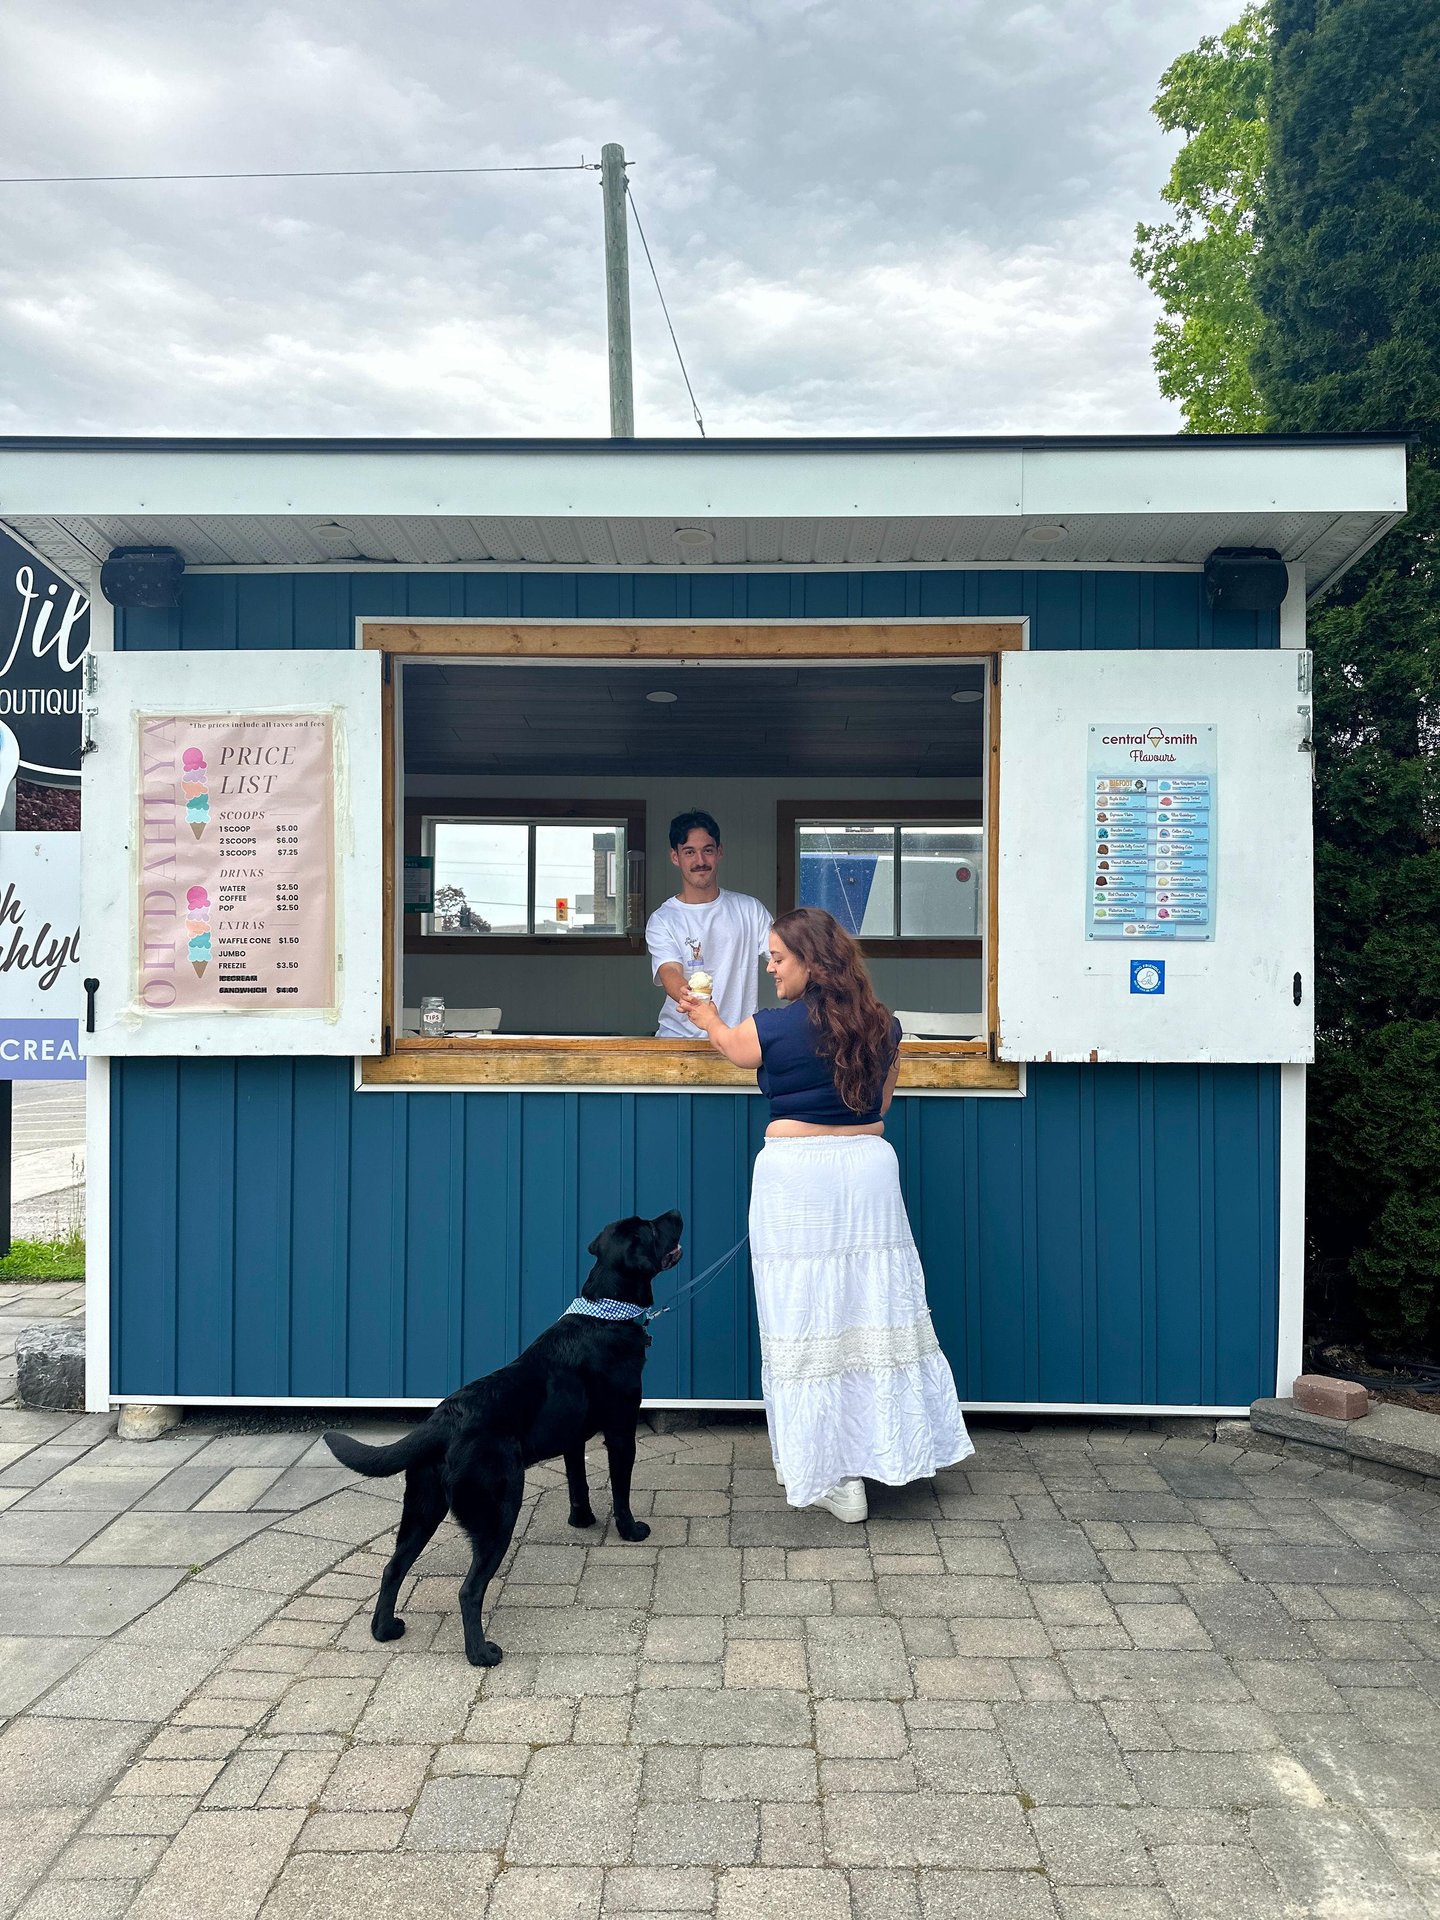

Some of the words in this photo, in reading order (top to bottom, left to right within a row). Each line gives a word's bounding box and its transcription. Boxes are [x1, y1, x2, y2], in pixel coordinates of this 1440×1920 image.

[1102, 734, 1146, 744] central
[1164, 734, 1198, 744] smith
[219, 746, 296, 765] PRICE
[1130, 750, 1176, 762] Flavours
[220, 775, 278, 794] LIST
[219, 811, 265, 820] SCOOPS
[220, 869, 264, 878] DRINKS
[219, 921, 265, 930] EXTRAS
[0, 1040, 85, 1061] CREA
